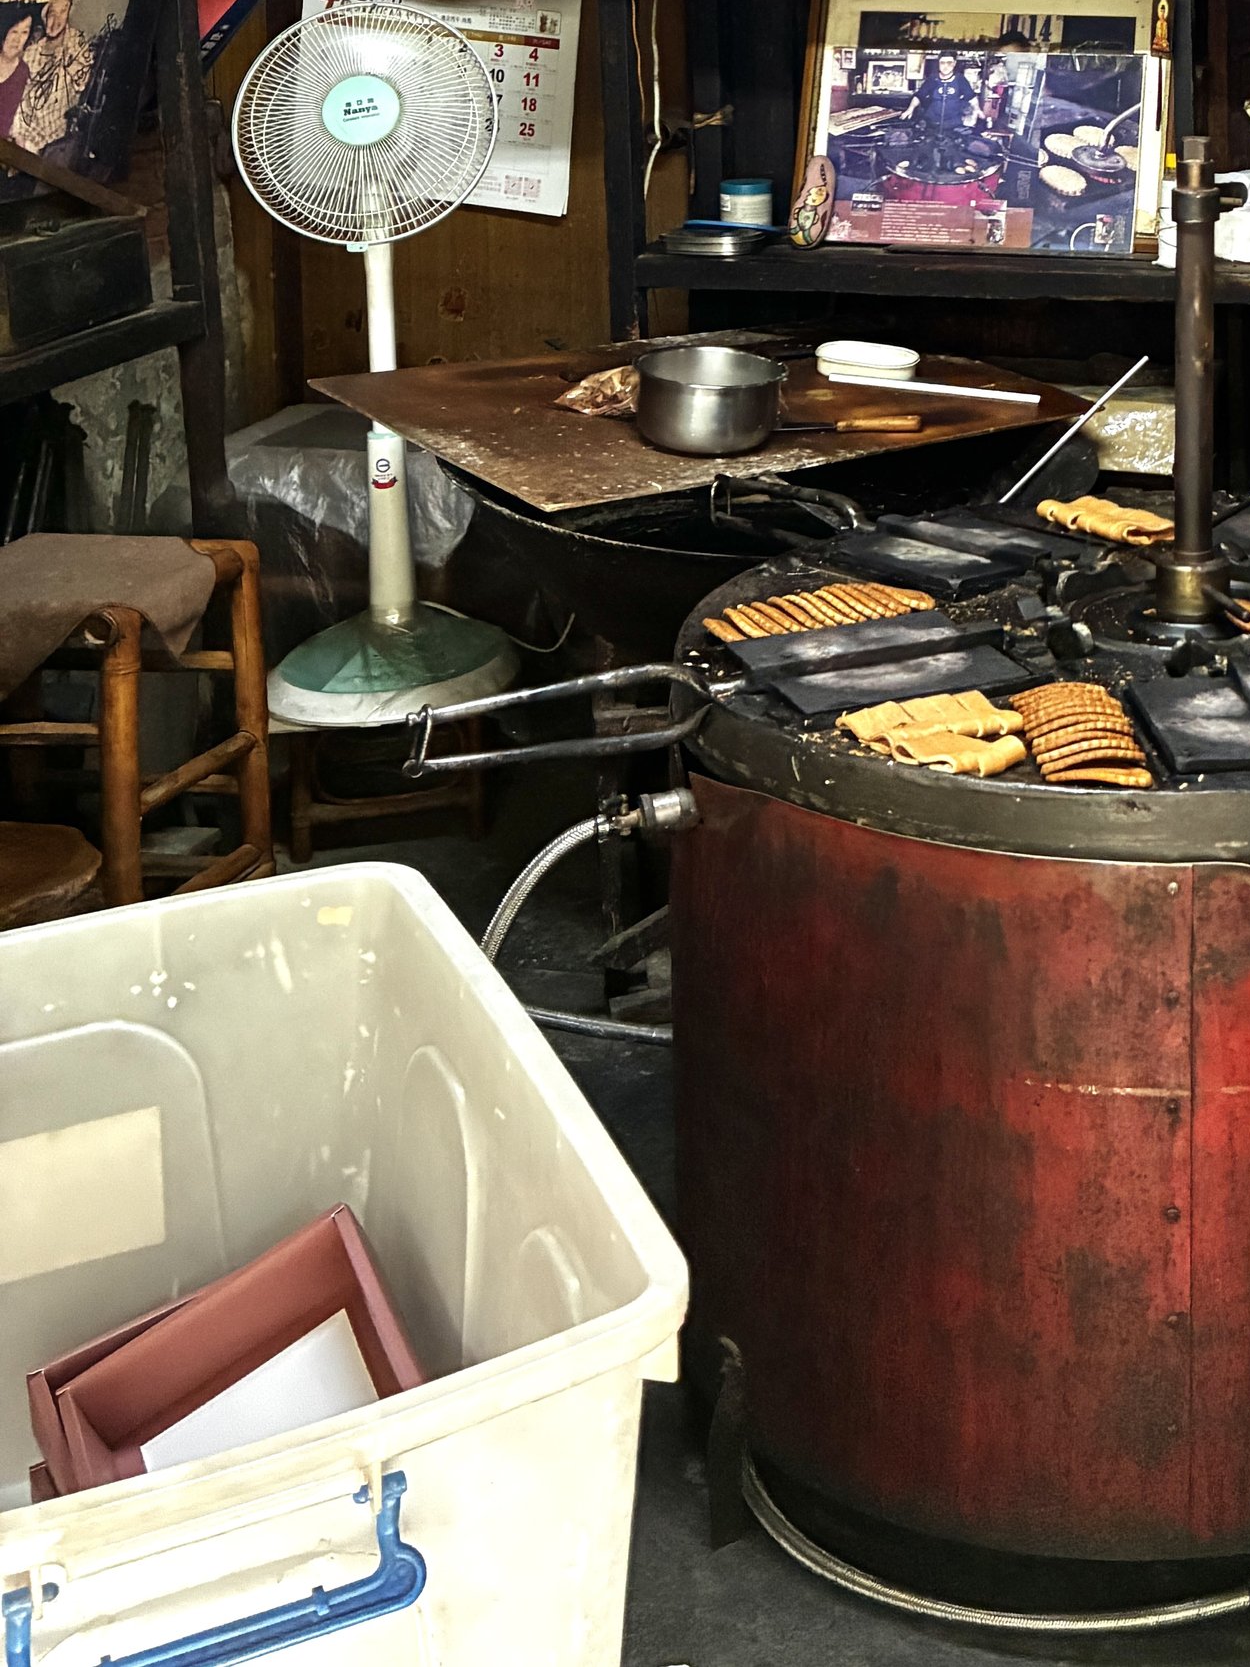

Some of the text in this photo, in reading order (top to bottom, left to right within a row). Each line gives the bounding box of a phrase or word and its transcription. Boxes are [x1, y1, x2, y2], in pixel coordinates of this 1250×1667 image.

[494, 43, 504, 58] 3
[528, 47, 539, 62] 4
[489, 68, 540, 87] 10 11
[343, 104, 378, 116] Nanya
[521, 97, 537, 112] 18
[519, 122, 535, 137] 25
